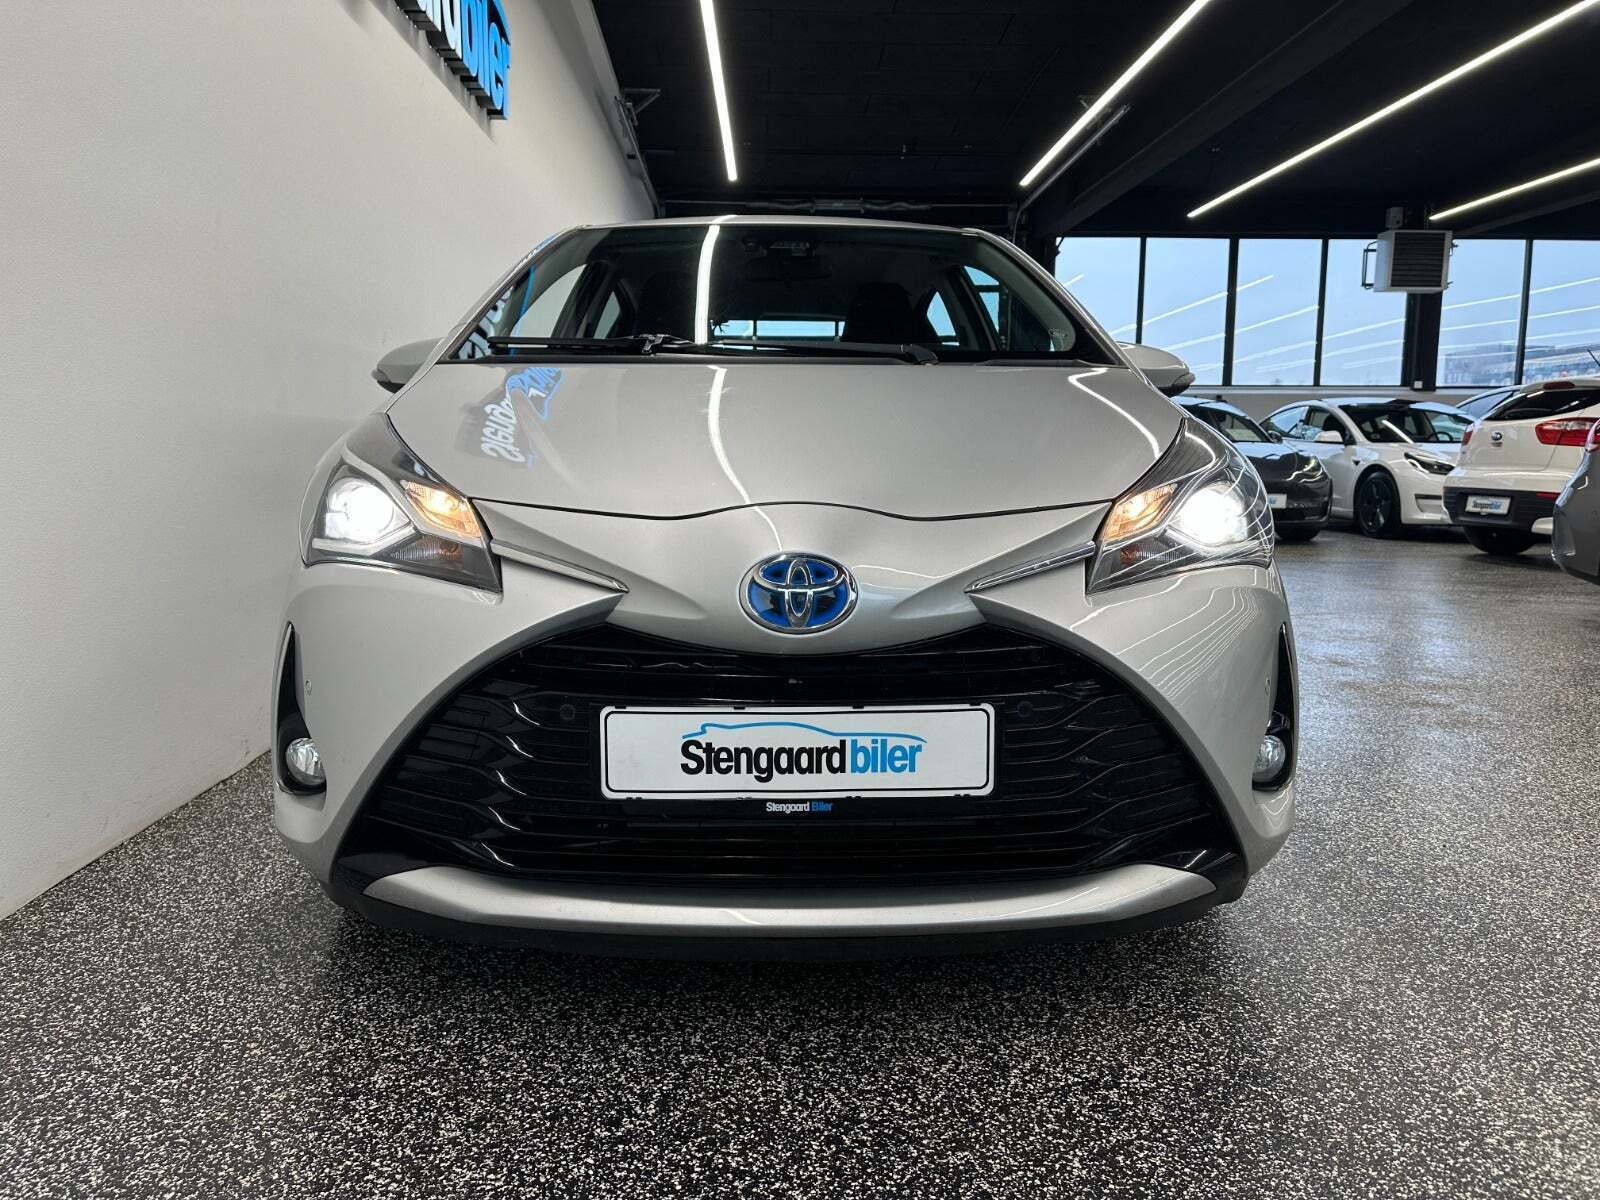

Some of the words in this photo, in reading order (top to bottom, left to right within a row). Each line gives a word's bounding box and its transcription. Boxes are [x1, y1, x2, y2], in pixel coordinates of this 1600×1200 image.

[680, 739, 847, 783] Stengaard
[849, 738, 922, 774] biler
[766, 801, 811, 814] Stengaard
[811, 800, 834, 812] Biler
